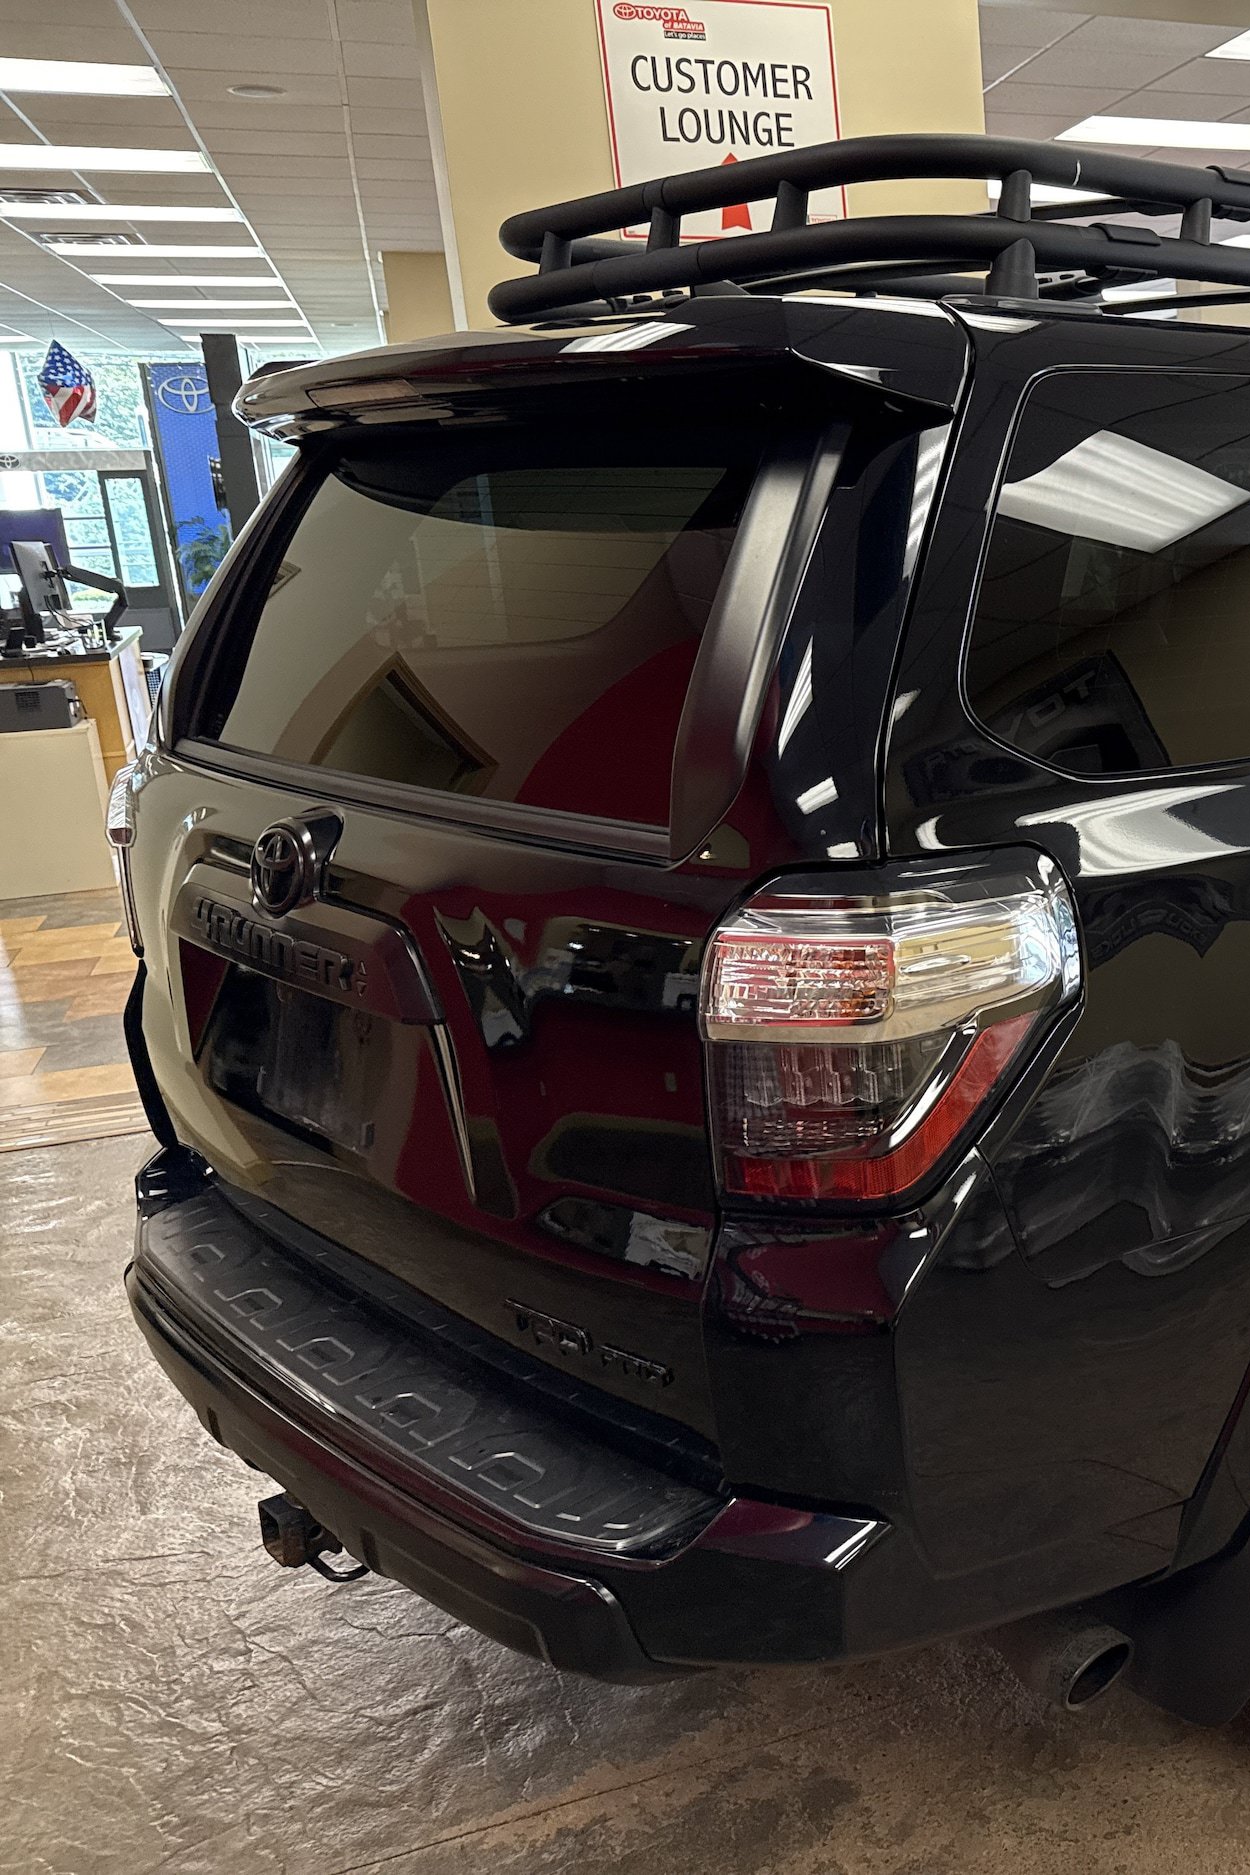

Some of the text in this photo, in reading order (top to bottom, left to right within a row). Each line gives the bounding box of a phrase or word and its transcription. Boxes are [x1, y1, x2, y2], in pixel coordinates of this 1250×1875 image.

[635, 7, 688, 20] TOYOTA
[673, 22, 704, 30] BATAVIA
[630, 54, 814, 100] CUSTOMER
[659, 106, 795, 148] LOUNGE
[190, 895, 355, 991] 4RUNNER
